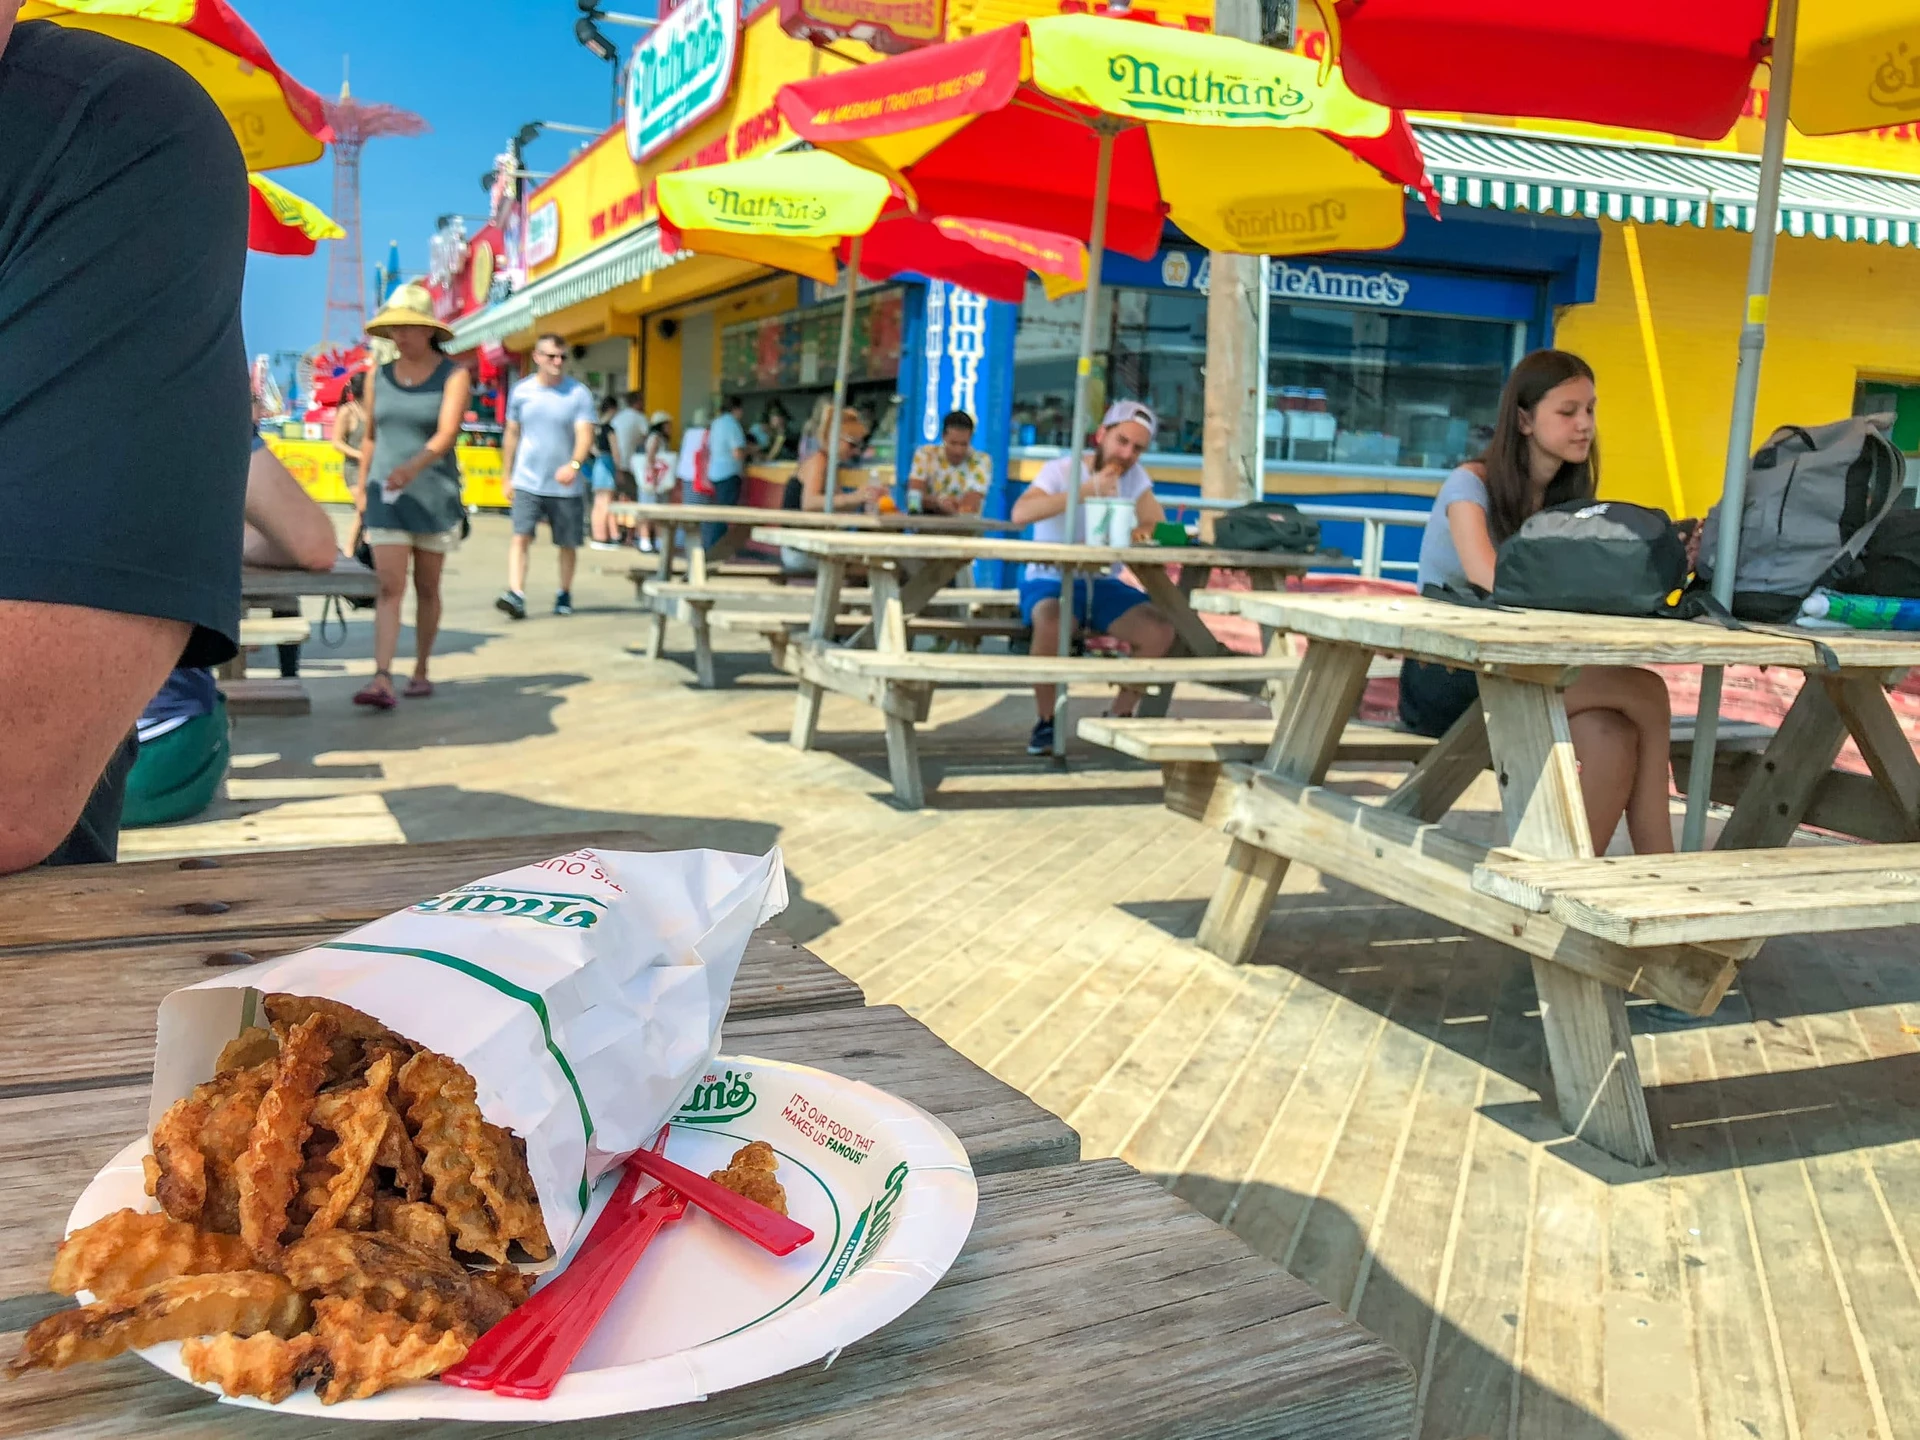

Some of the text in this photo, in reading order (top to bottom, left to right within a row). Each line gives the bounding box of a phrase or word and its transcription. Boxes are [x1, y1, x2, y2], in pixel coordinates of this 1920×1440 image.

[1108, 53, 1305, 107] Nathan's
[708, 187, 826, 220] Nathan's
[781, 1106, 814, 1137] MAKES
[812, 1130, 827, 1146] US
[790, 1093, 875, 1152] IT'S OUR FOOD THAT
[832, 1239, 857, 1279] FAMOUS
